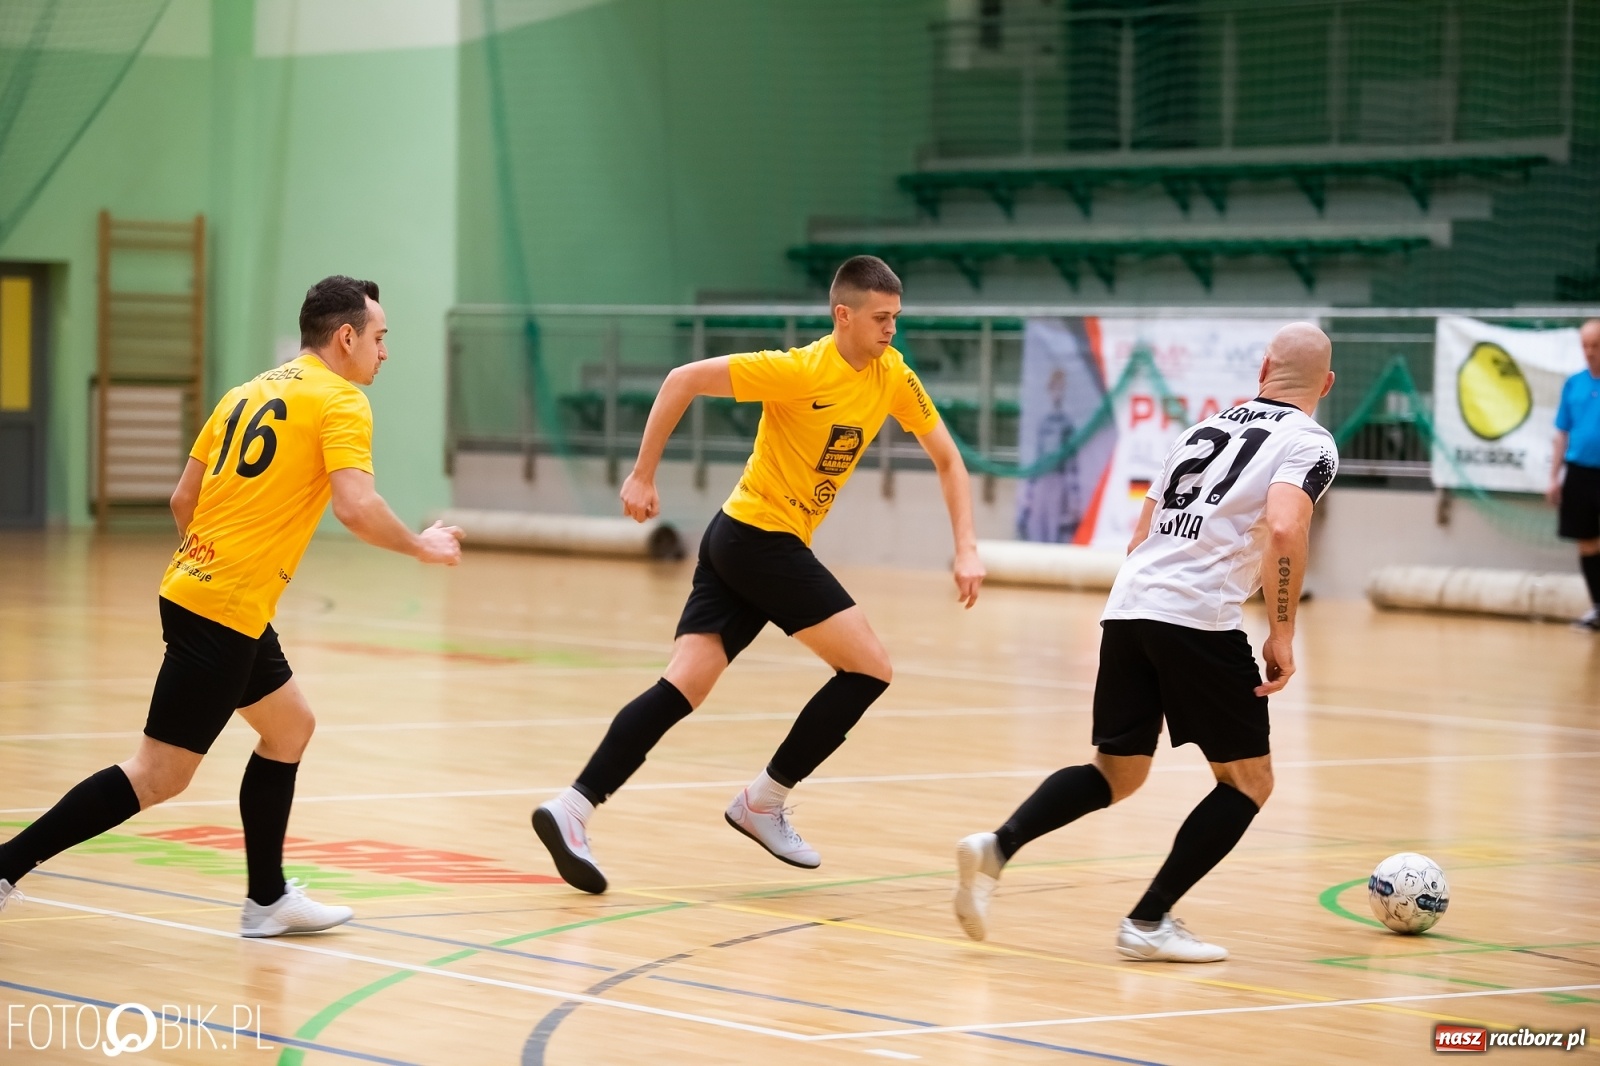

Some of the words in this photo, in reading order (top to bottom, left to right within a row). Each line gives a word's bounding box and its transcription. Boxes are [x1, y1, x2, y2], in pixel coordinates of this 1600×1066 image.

[907, 374, 931, 420] WINDAR
[212, 398, 287, 479] 16
[1162, 426, 1272, 510] 21
